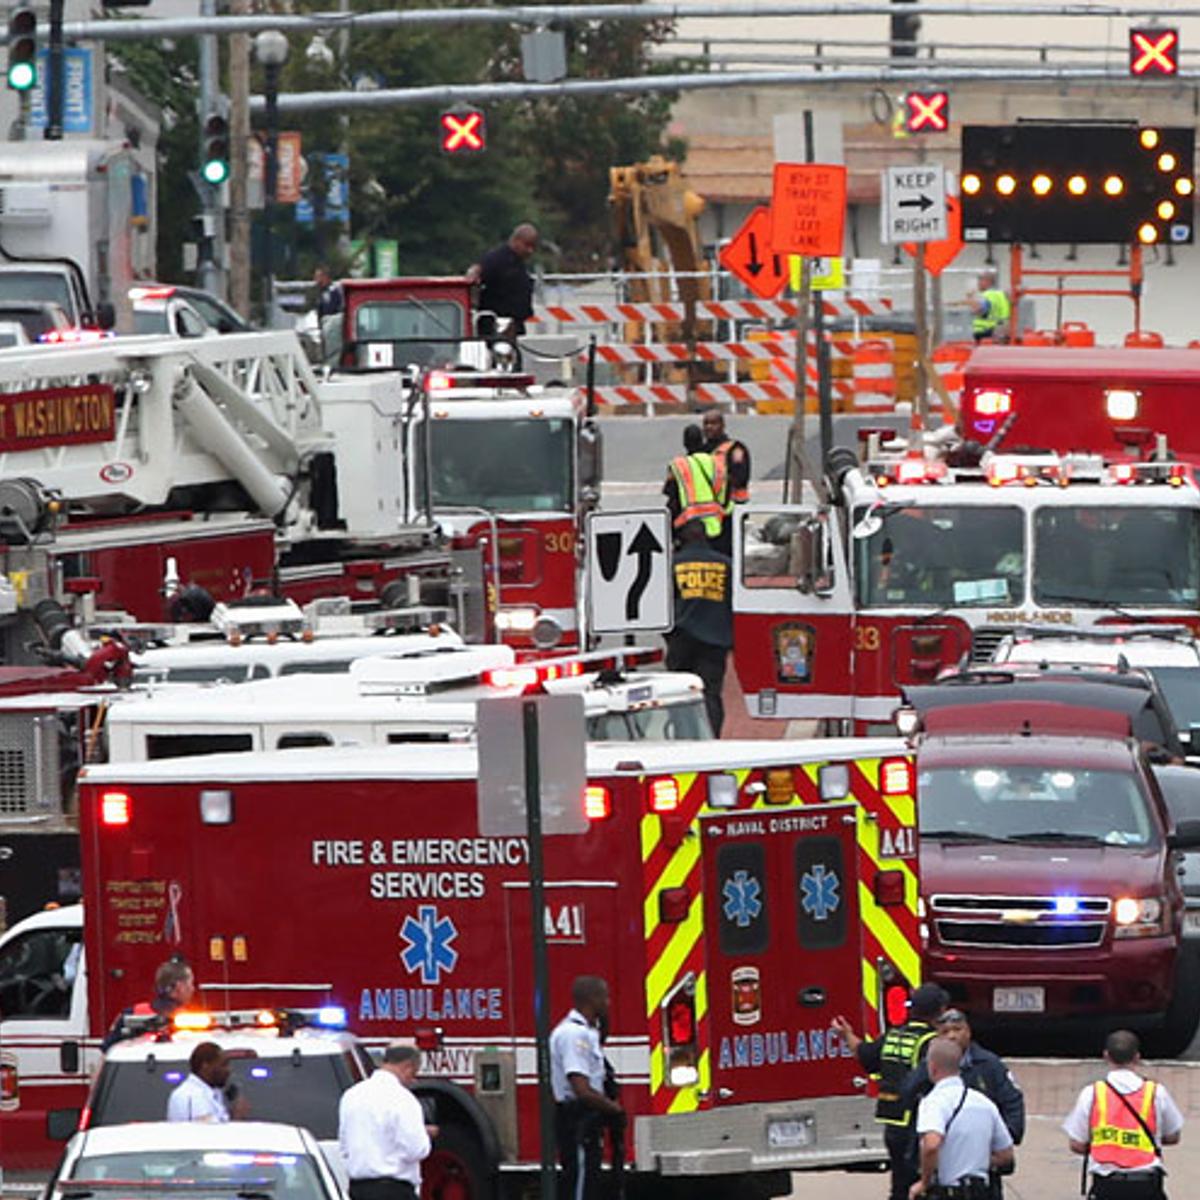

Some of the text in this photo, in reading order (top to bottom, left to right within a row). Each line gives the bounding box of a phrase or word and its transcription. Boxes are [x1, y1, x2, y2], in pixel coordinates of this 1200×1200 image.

[895, 172, 937, 189] KEEP
[893, 217, 939, 234] RIGHT
[13, 393, 111, 438] WASHINGTON
[544, 533, 571, 552] 30
[677, 573, 727, 590] POLICE
[726, 815, 829, 837] NAVAL DISTRICT
[312, 838, 529, 866] FIRE & EMERGENCY
[882, 828, 915, 855] A41
[370, 871, 485, 898] SERVICES
[359, 987, 504, 1021] AMBULANCE
